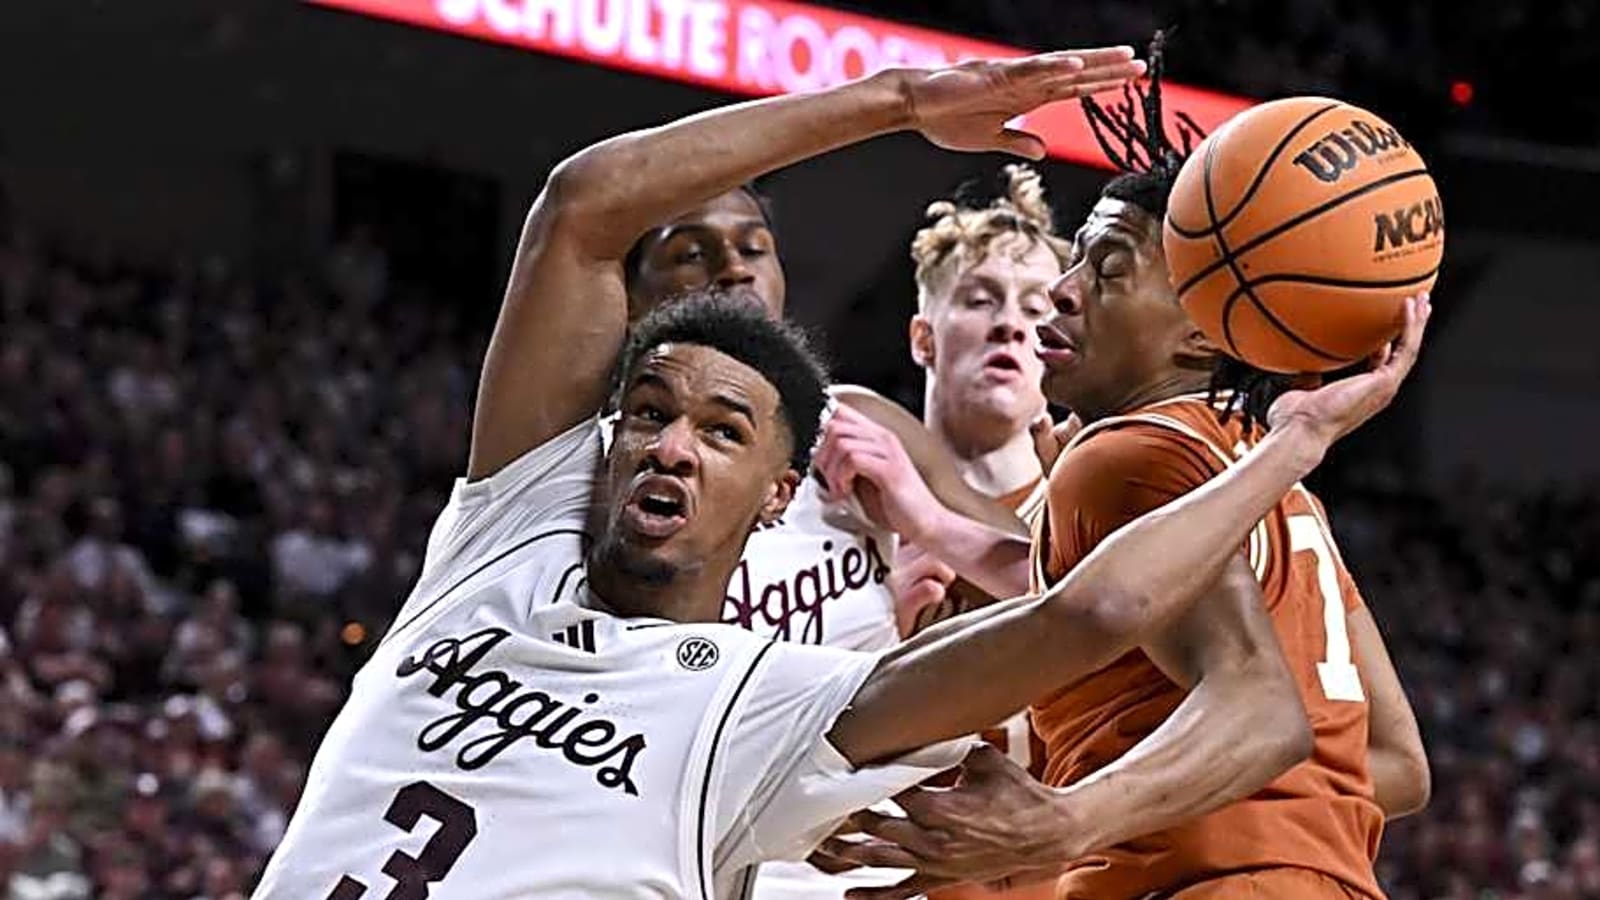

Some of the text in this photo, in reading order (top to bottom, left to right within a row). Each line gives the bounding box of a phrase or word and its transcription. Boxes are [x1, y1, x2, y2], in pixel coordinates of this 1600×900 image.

[720, 536, 890, 645] Aggies
[679, 639, 717, 669] SEC
[397, 628, 646, 796] Aggies
[326, 781, 478, 900] 3
